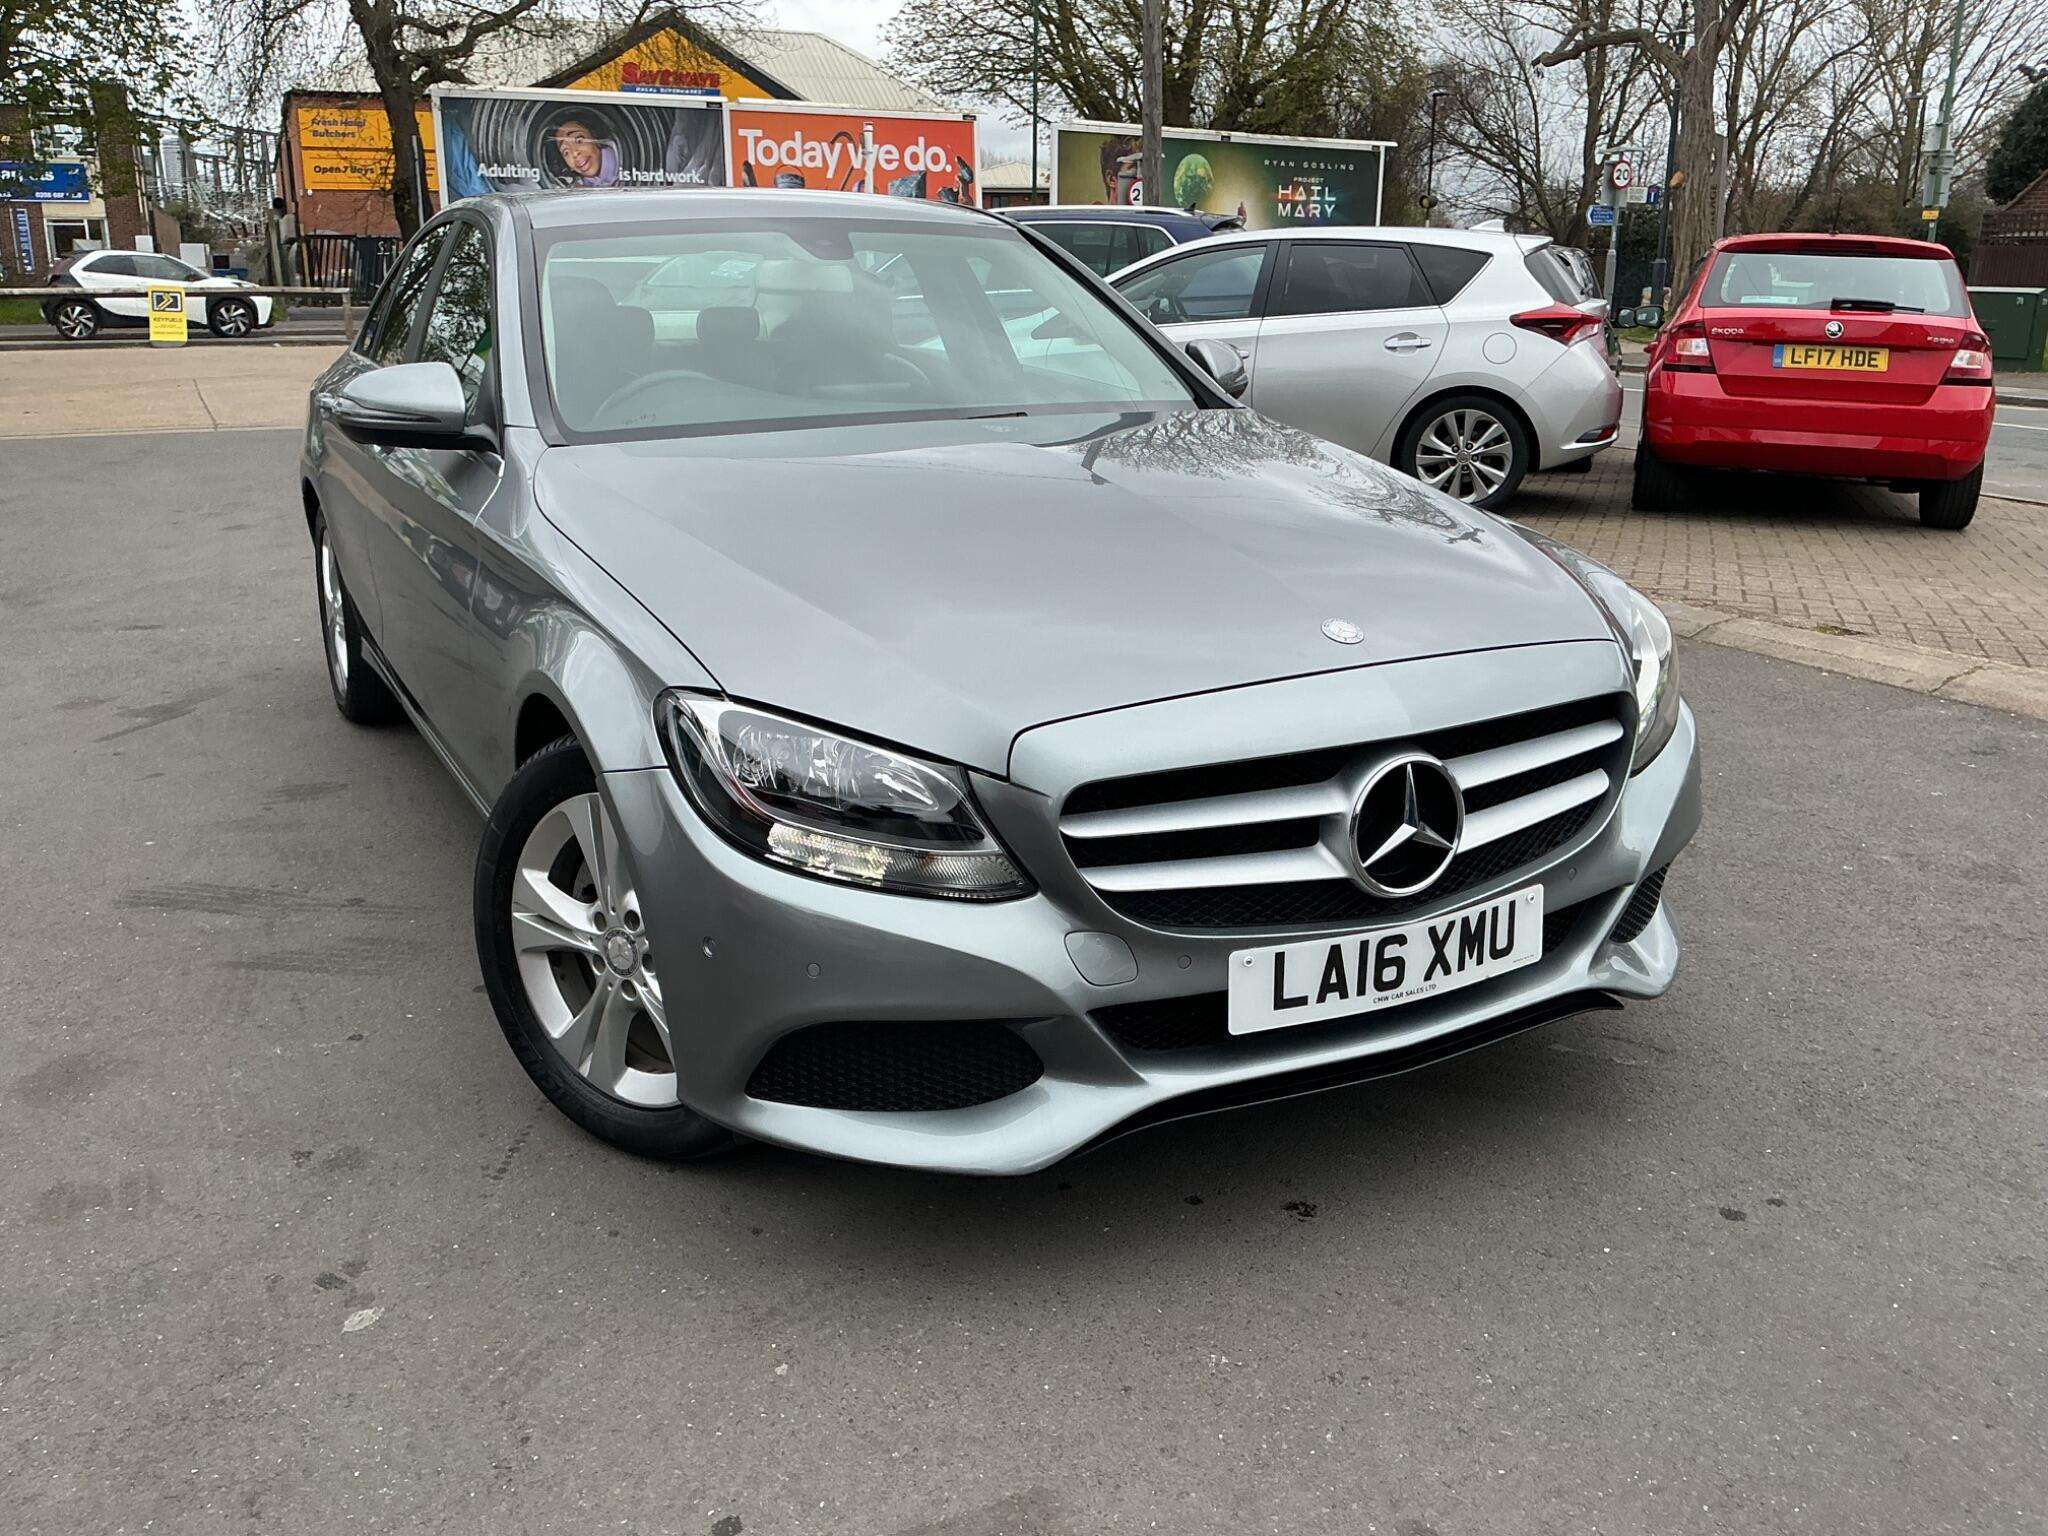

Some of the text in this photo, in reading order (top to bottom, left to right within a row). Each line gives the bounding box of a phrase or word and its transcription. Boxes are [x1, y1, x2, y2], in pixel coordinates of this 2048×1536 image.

[738, 129, 842, 179] Today
[903, 136, 953, 173] do.
[313, 165, 343, 174] Open
[1264, 159, 1355, 171] RYAN GOSLING
[477, 163, 705, 184] Adulting is hard work.
[1293, 176, 1325, 184] PROJECT
[1615, 168, 1629, 181] 20
[1132, 188, 1141, 202] 2
[1278, 184, 1337, 201] HAIL
[1277, 202, 1336, 218] MARY
[1790, 347, 1879, 368] LF17 HDE
[1273, 900, 1516, 1011] LA16 XMU
[1391, 990, 1404, 1000] CAR
[1405, 986, 1424, 996] SALES
[1425, 983, 1437, 992] LTD
